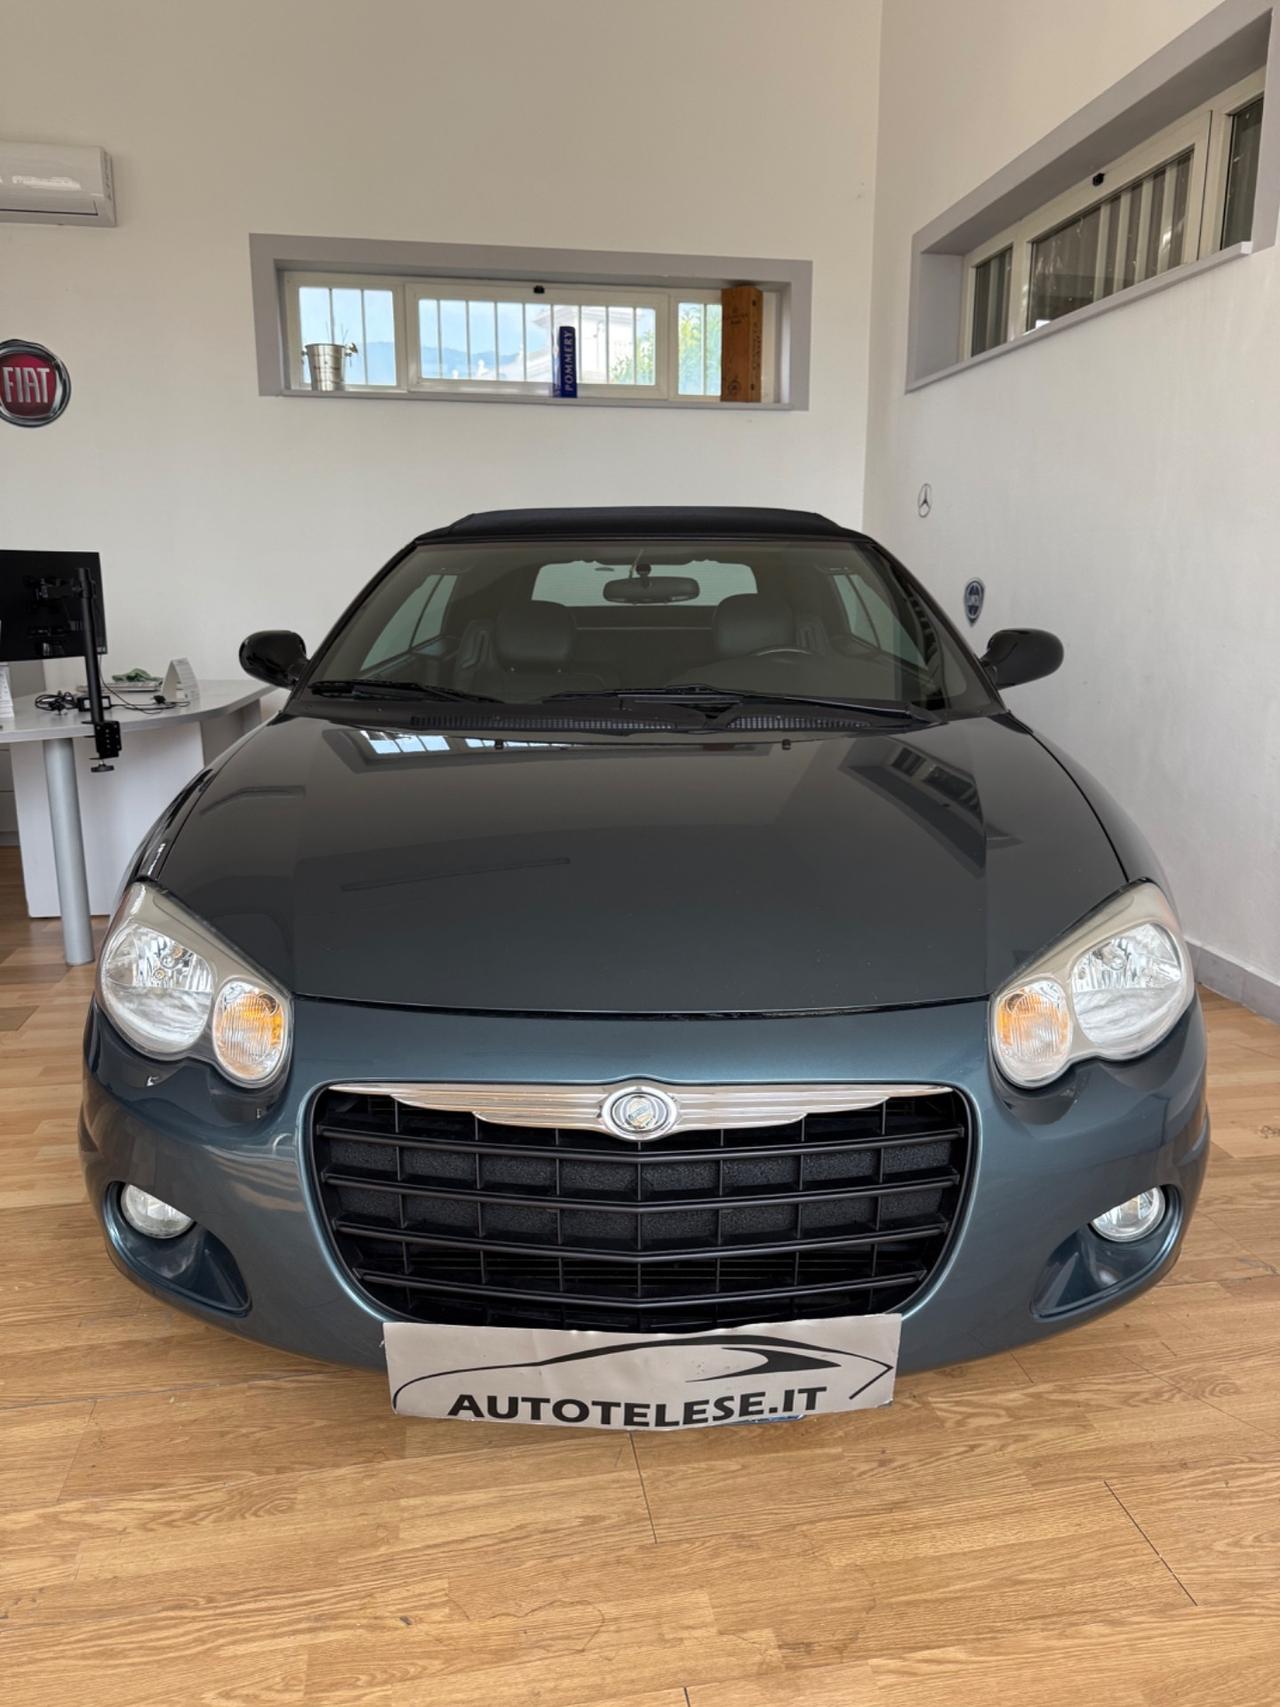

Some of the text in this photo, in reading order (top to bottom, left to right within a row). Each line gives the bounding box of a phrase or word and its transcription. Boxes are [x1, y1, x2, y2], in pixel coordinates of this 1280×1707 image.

[563, 330, 574, 392] POMMERY
[2, 366, 50, 403] FIAT
[447, 1386, 828, 1427] AUTOTELESE.IT
